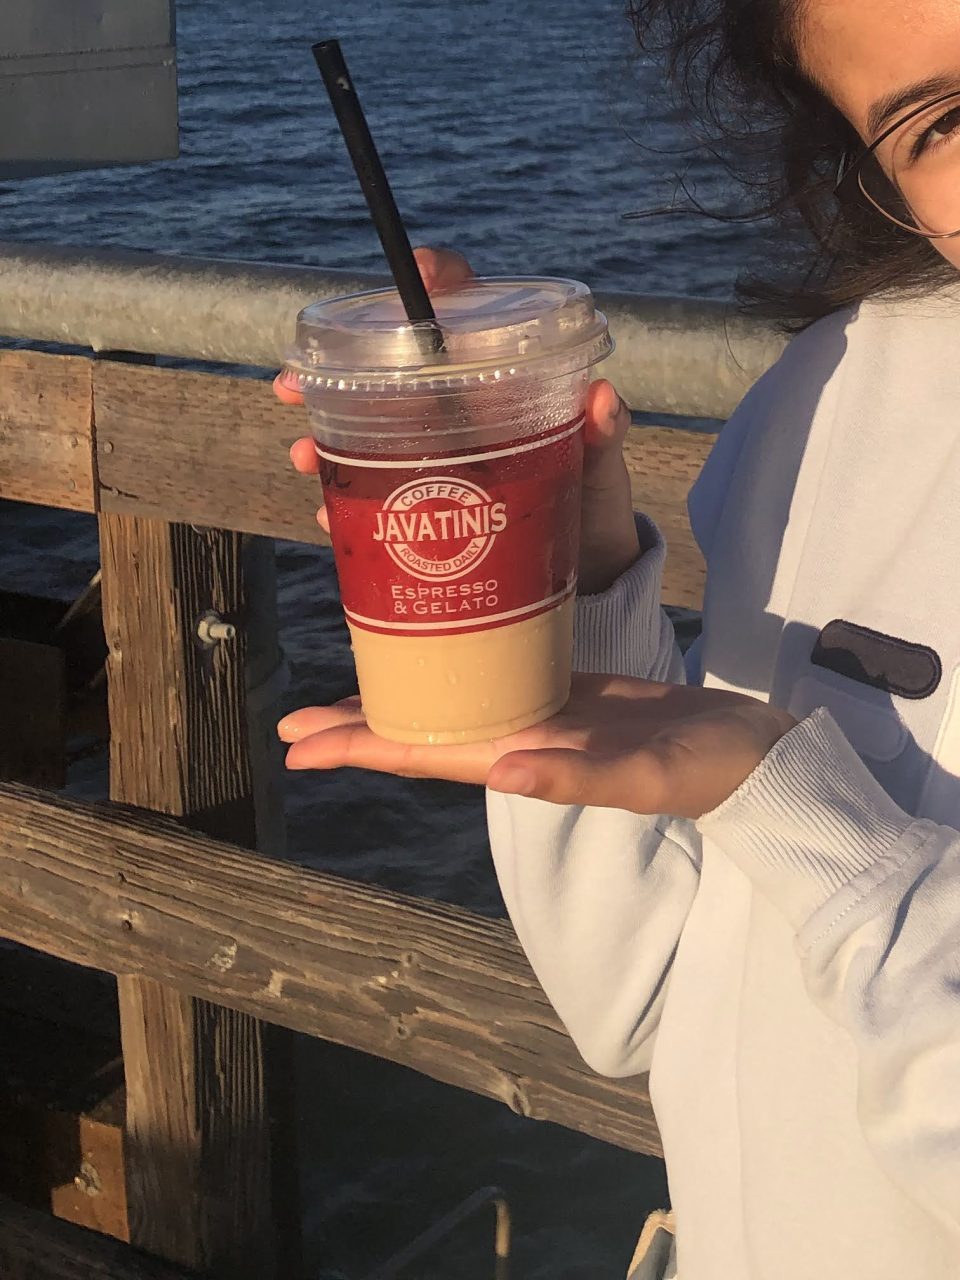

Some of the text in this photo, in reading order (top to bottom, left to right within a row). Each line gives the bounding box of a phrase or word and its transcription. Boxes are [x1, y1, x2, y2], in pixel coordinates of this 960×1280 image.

[400, 485, 472, 507] COFFEE
[372, 502, 507, 541] JAVATINIS
[400, 541, 481, 572] ROASTED DAILY
[391, 580, 498, 599] ESPRESSO
[393, 595, 498, 615] & GELATO
